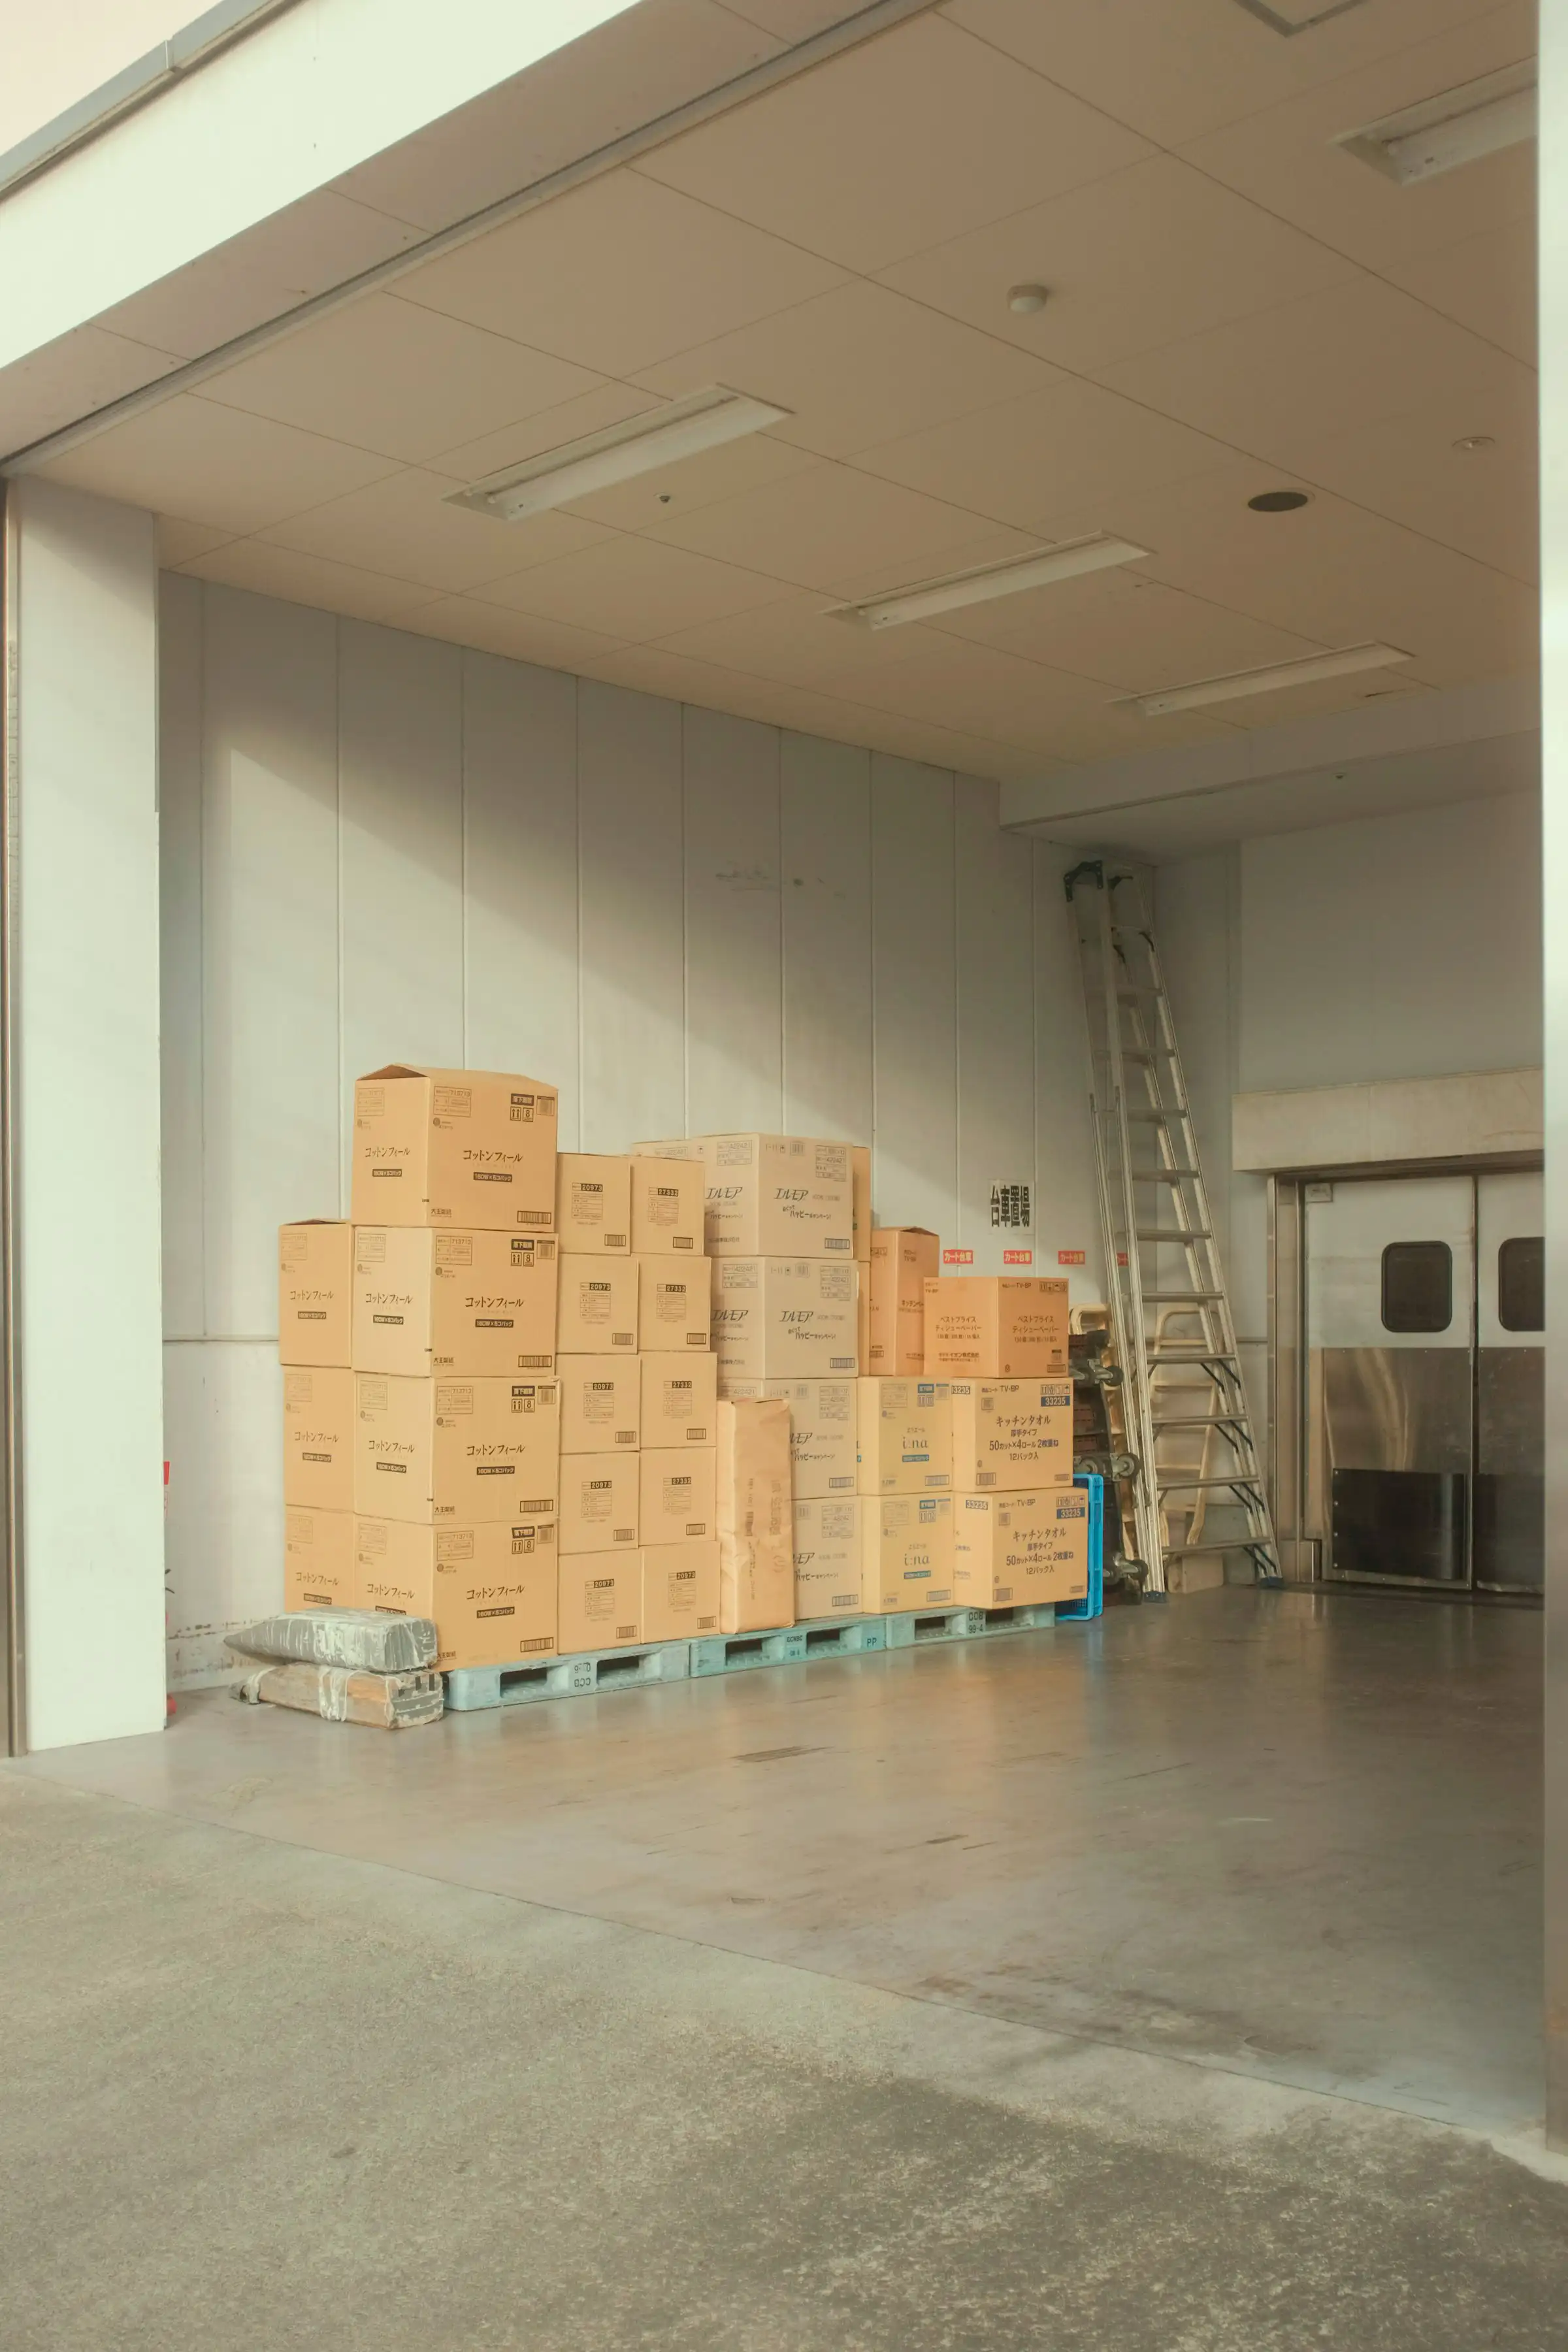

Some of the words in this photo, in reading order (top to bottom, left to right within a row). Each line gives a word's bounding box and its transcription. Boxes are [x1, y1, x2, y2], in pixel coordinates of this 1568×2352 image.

[365, 1147, 411, 1158] コットンフィール
[463, 1149, 523, 1164] コットンフィール
[706, 1187, 743, 1199] エルモア
[774, 1188, 809, 1201] エルモア
[990, 1184, 1030, 1228] 台車置場
[945, 1252, 972, 1262] カート台車
[1005, 1252, 1031, 1262] カート台車
[1060, 1252, 1085, 1262] カート台車
[289, 1290, 334, 1301] コットンフィール
[365, 1292, 414, 1305] コットンフィール
[465, 1296, 524, 1309] コットンフィール
[711, 1309, 749, 1322] エルモア
[779, 1311, 814, 1323] エルモア
[1045, 1397, 1066, 1406] 33235
[996, 1414, 1051, 1428] キッチンタオル
[790, 1432, 813, 1445] ルモア
[368, 1439, 415, 1453] コットンフィール
[466, 1443, 525, 1456] コットンフィール
[591, 1481, 612, 1490] 20973
[1060, 1508, 1081, 1518] 33235
[1013, 1527, 1066, 1542] キッチンタオル
[676, 1571, 696, 1580] 20973
[594, 1579, 615, 1588] 20973
[367, 1583, 416, 1599] コットンフィール
[466, 1584, 525, 1600] コットンフィール
[866, 1638, 877, 1647] PP
